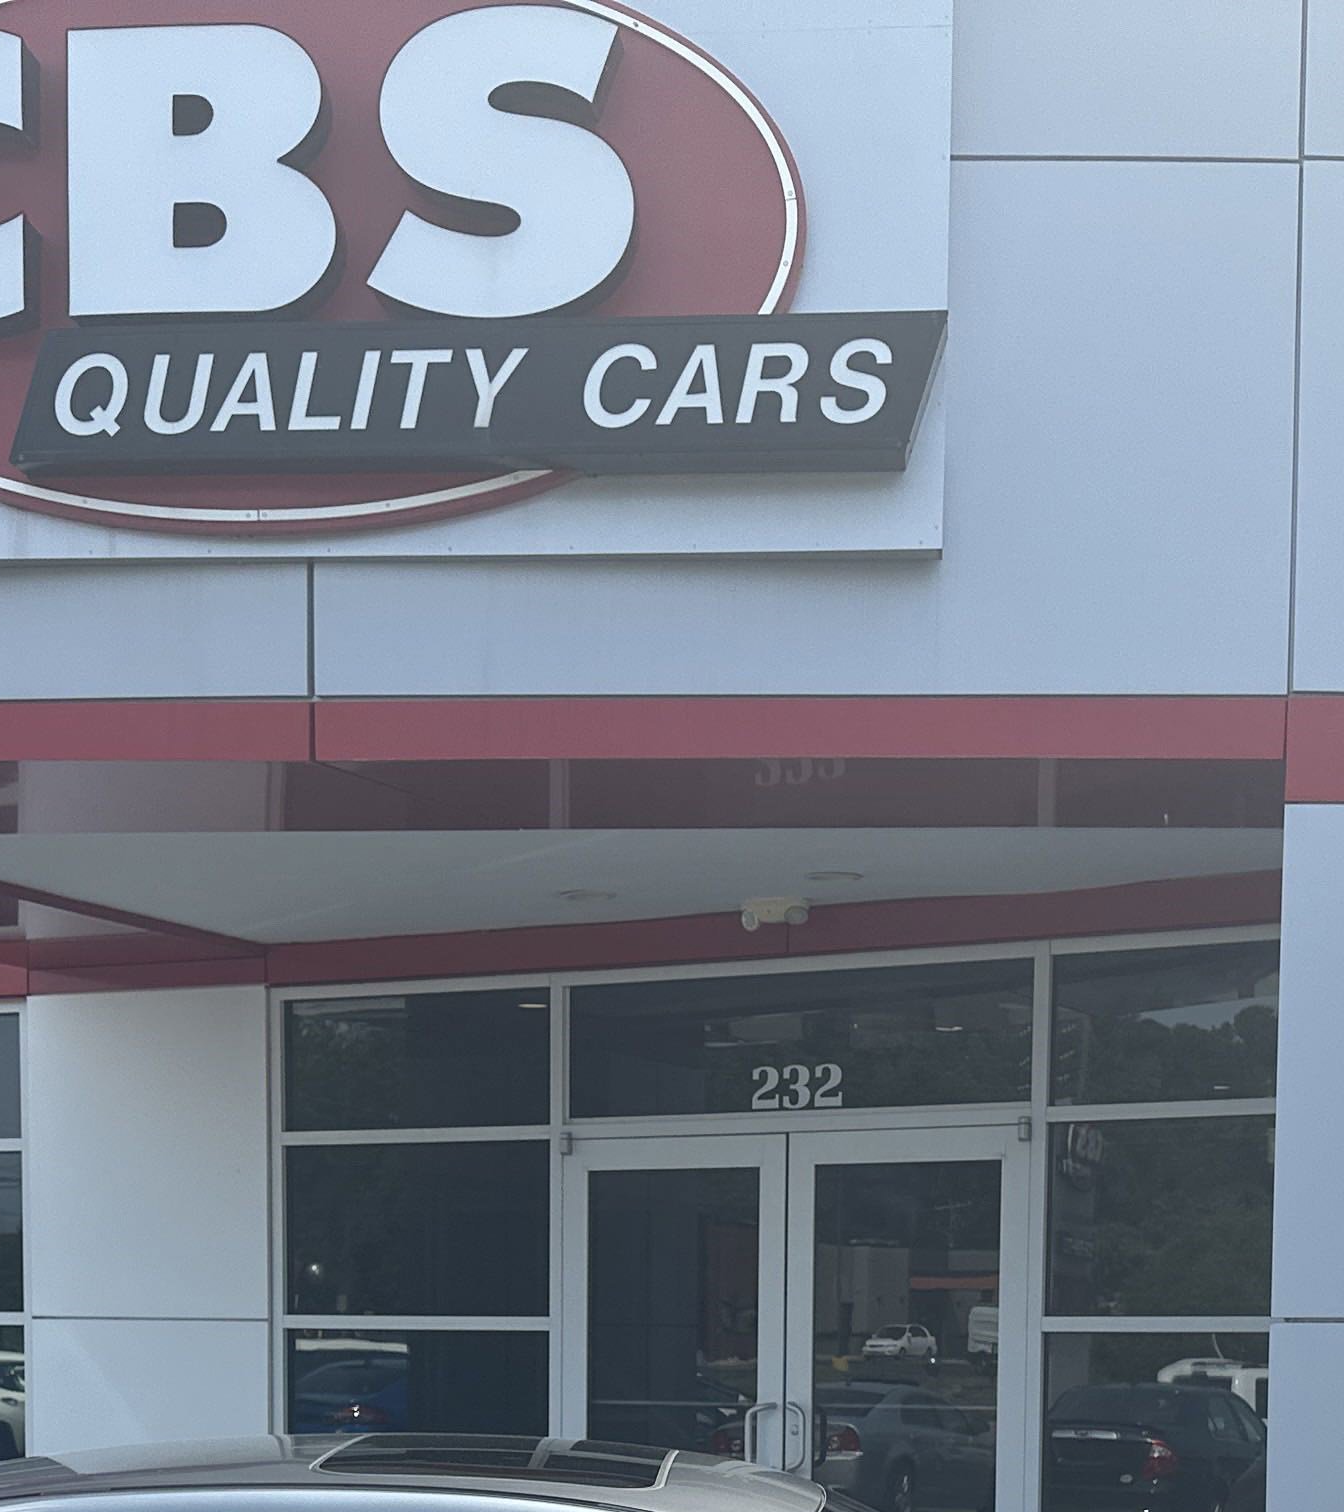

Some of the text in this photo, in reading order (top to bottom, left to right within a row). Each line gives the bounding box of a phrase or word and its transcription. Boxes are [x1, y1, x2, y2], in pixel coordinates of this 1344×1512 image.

[54, 337, 893, 438] QUALITY CARS
[751, 1063, 843, 1110] 232
